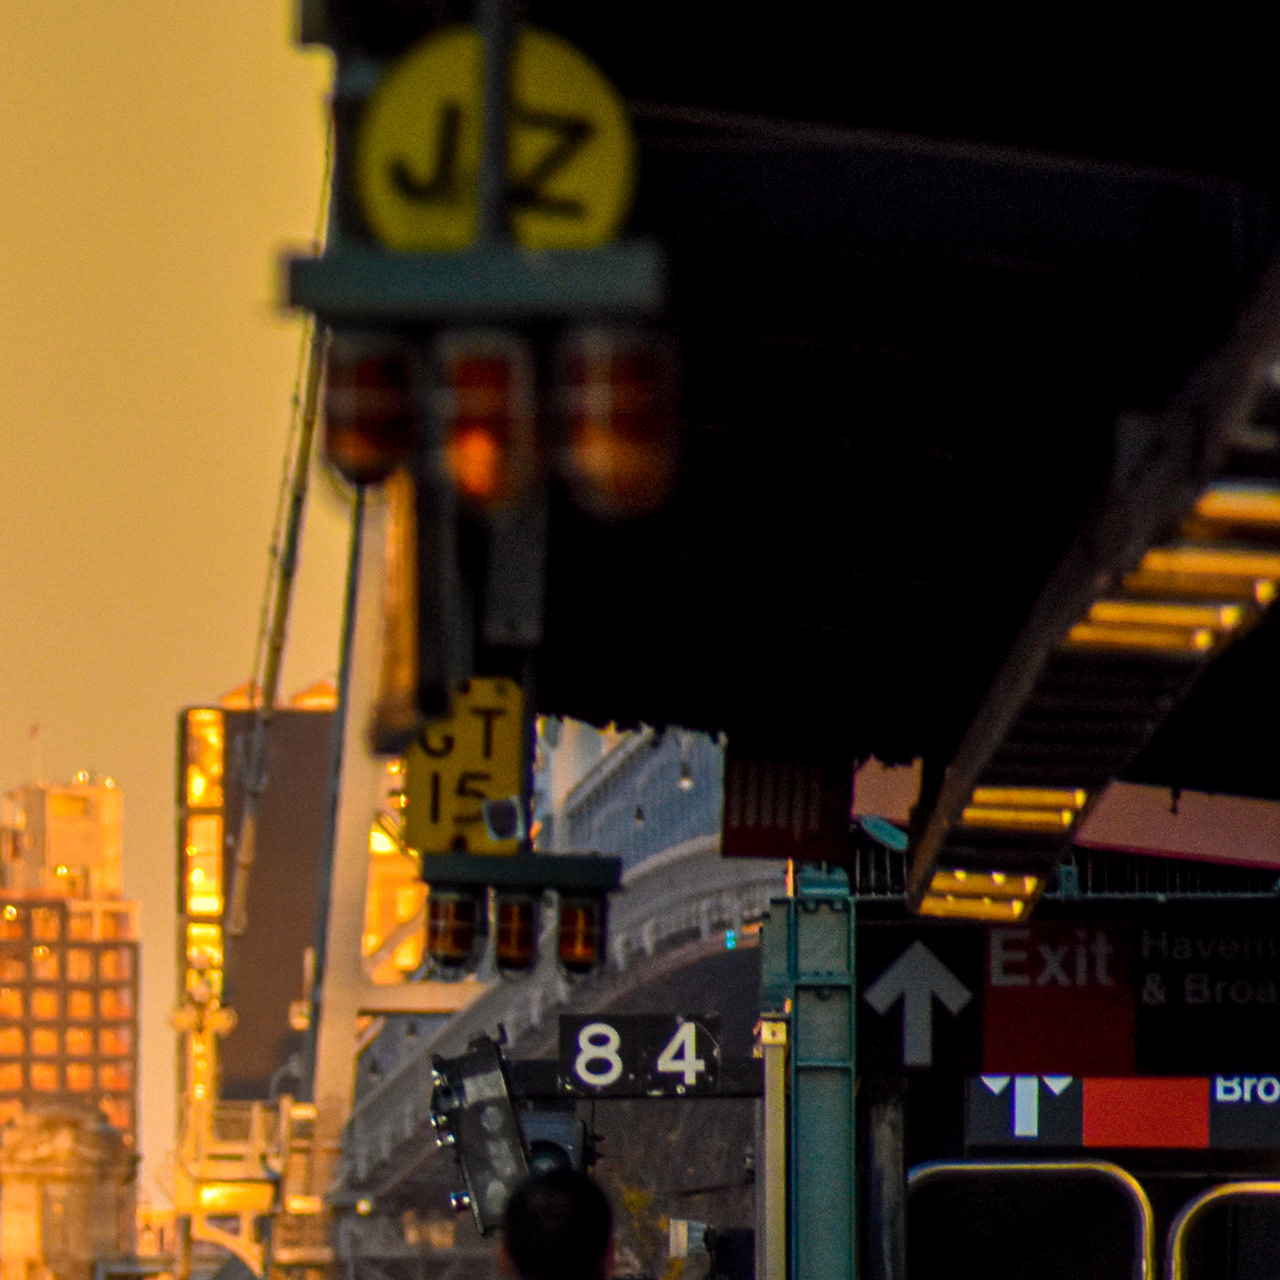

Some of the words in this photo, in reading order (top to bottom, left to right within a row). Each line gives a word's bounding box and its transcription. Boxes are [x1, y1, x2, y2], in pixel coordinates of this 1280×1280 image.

[390, 98, 464, 206] J
[502, 104, 596, 222] Z
[429, 769, 493, 826] 15
[988, 927, 1115, 988] Exit
[1142, 972, 1168, 1005] &
